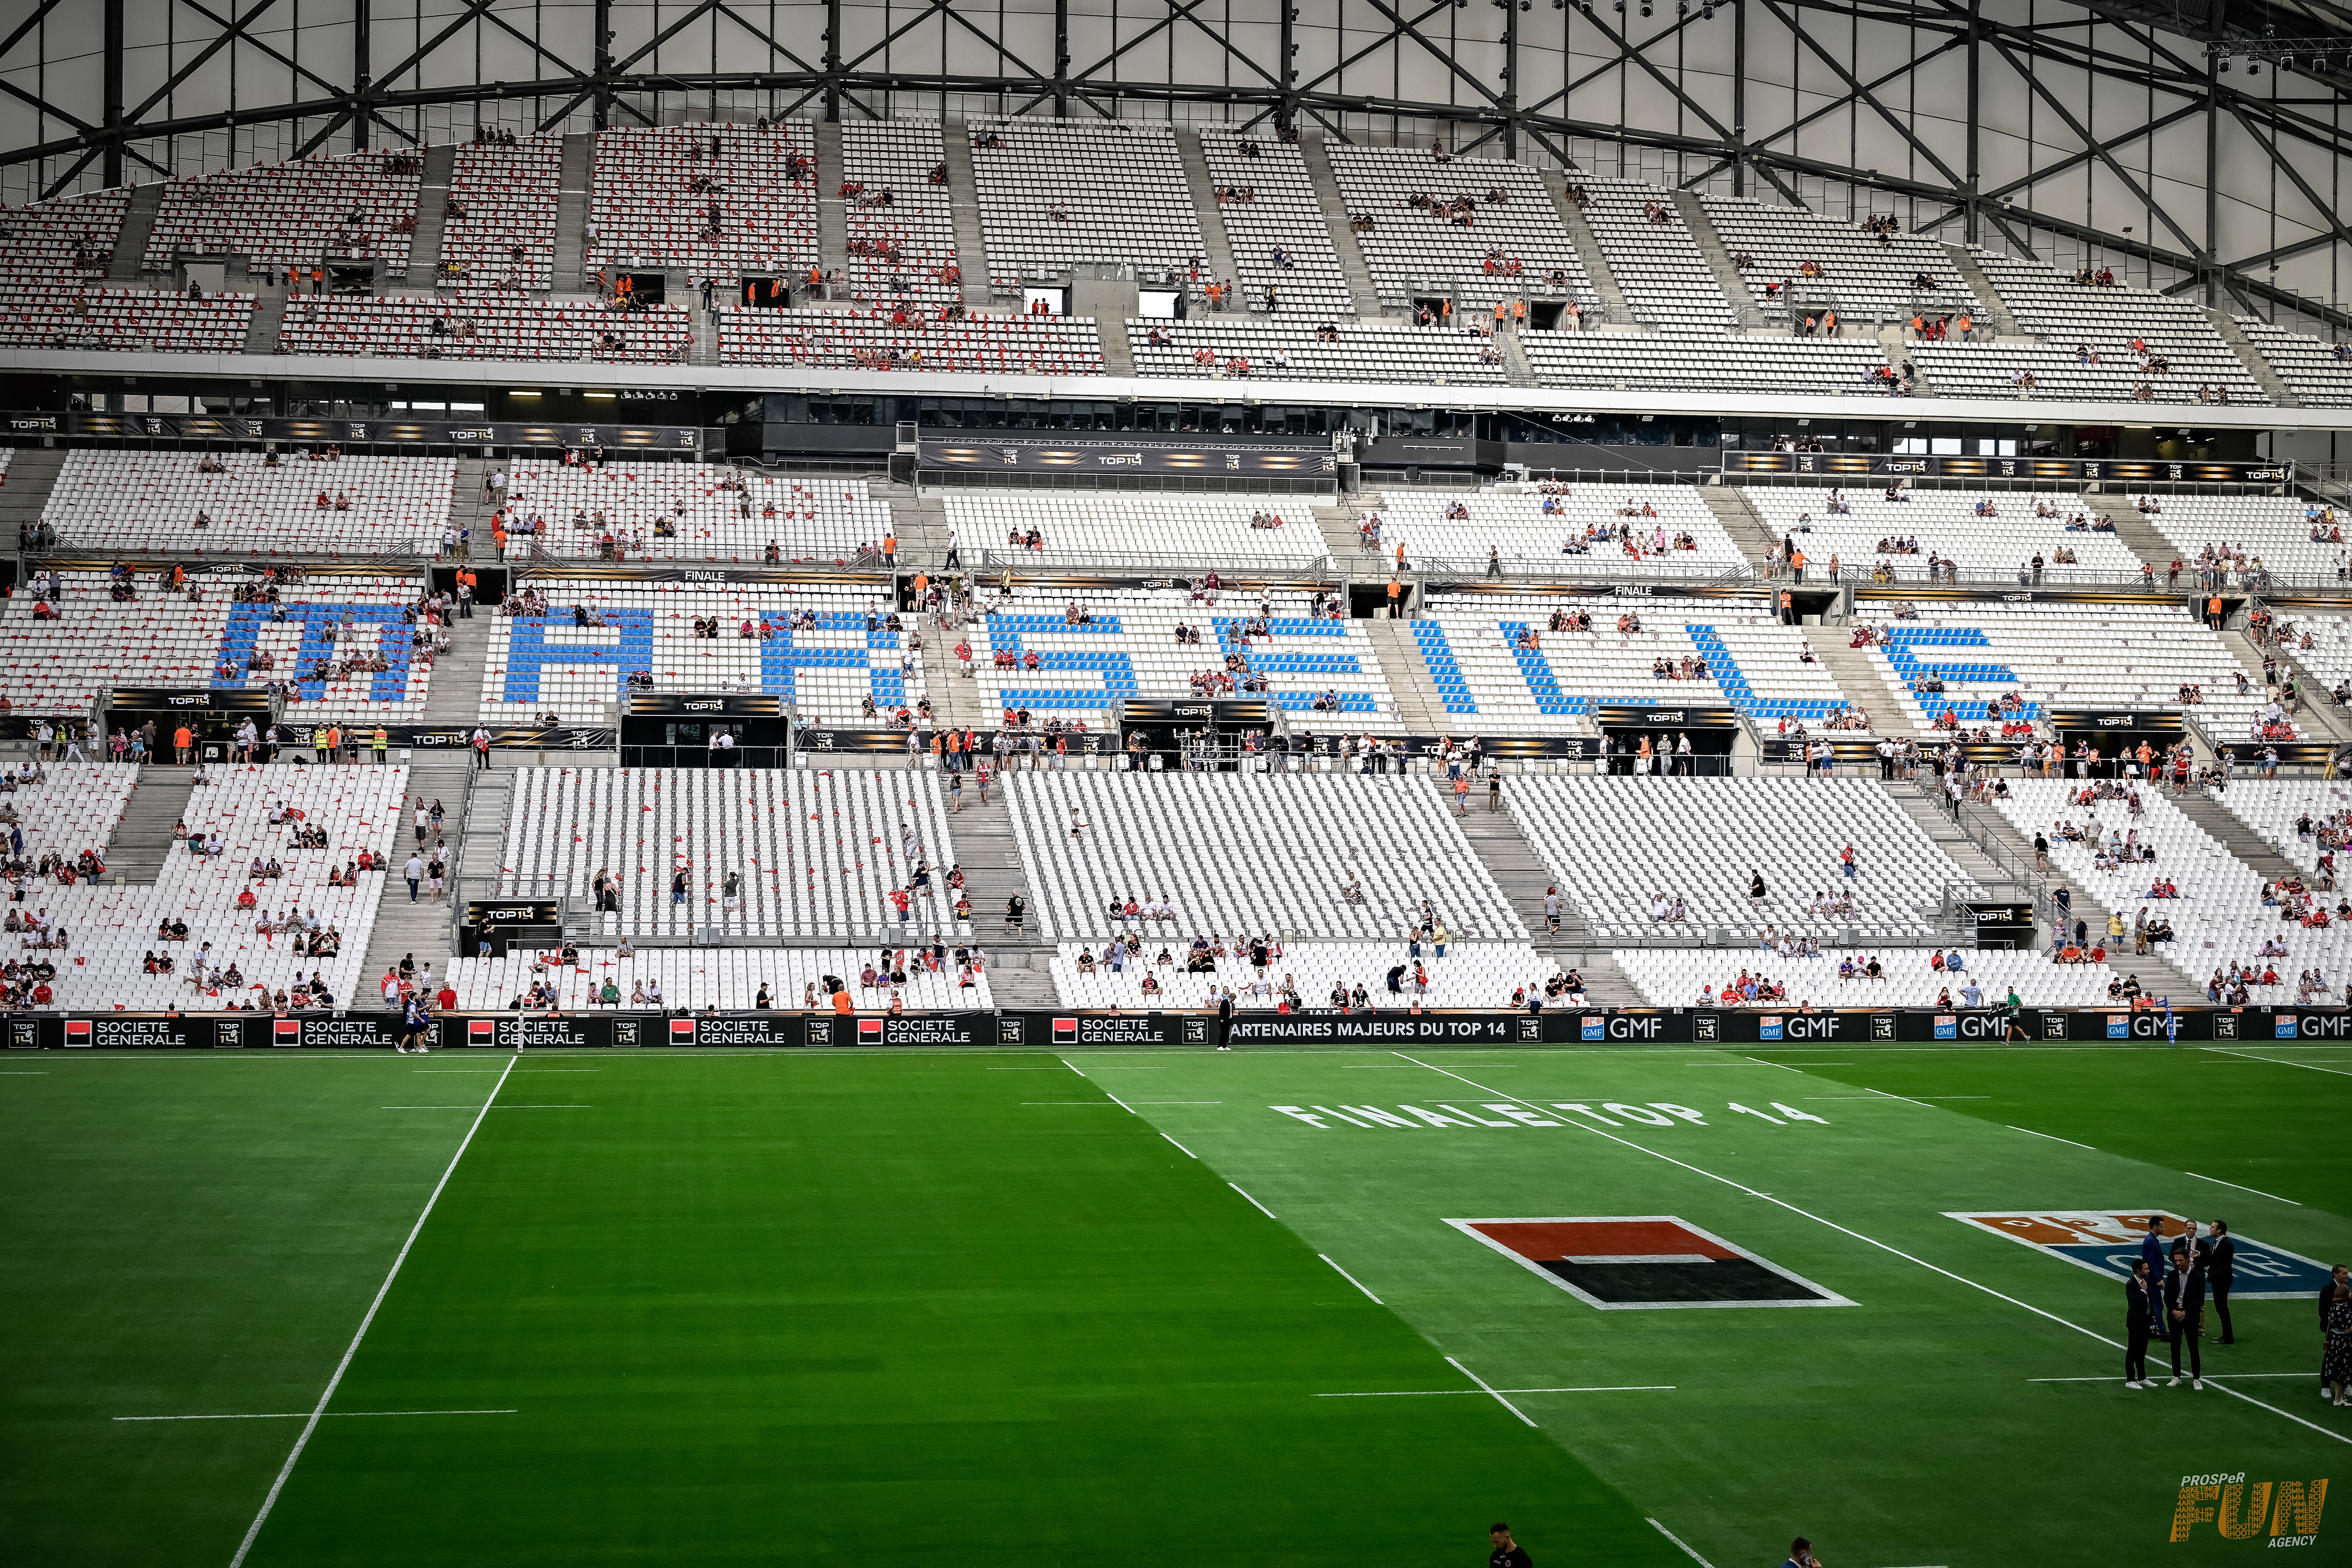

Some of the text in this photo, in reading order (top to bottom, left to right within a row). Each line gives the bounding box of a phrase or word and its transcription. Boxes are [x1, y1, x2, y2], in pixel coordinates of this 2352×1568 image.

[685, 571, 725, 581] FINALE
[1615, 586, 1652, 595] FINALE
[97, 1022, 169, 1033] SOCIETE
[305, 1022, 376, 1032] SOCIETE
[499, 1022, 569, 1032] SOCIETE
[701, 1020, 769, 1031] SOCIETE
[888, 1020, 955, 1030] SOCIETE
[1082, 1019, 1148, 1030] SOCIETE
[1231, 1022, 1506, 1036] ARTENAIRES MAJEURS DU TOP 14
[1610, 1018, 1661, 1038] GMF
[1789, 1017, 1839, 1038] GMF
[1962, 1017, 2010, 1036] GMF
[2134, 1017, 2183, 1036] GMF
[2302, 1017, 2350, 1035] GMF
[14, 1035, 33, 1044] 14
[97, 1035, 186, 1045] GENERALE
[219, 1035, 238, 1043] 14
[305, 1034, 392, 1044] GENERALE
[499, 1034, 584, 1044] GENERALE
[700, 1033, 784, 1043] GENERALE
[888, 1033, 970, 1042] GENERALE
[1082, 1031, 1163, 1041] GENERALE
[1268, 1102, 1831, 1128] FINALE TOP 14
